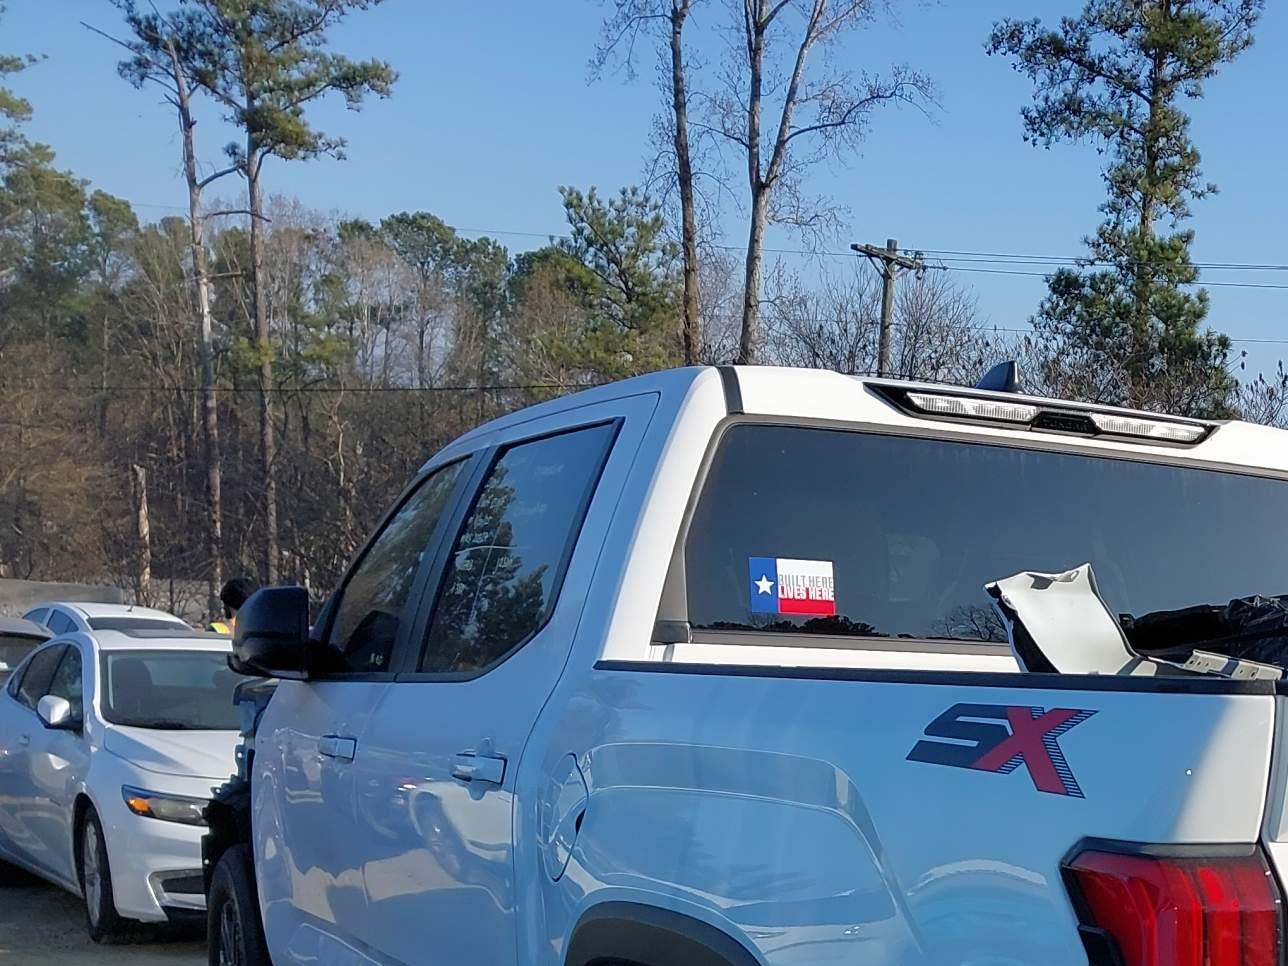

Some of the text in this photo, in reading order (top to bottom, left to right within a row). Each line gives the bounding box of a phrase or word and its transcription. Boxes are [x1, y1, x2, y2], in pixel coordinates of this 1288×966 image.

[778, 574, 833, 588] BUILT HERE
[778, 586, 834, 601] LIVES HERE
